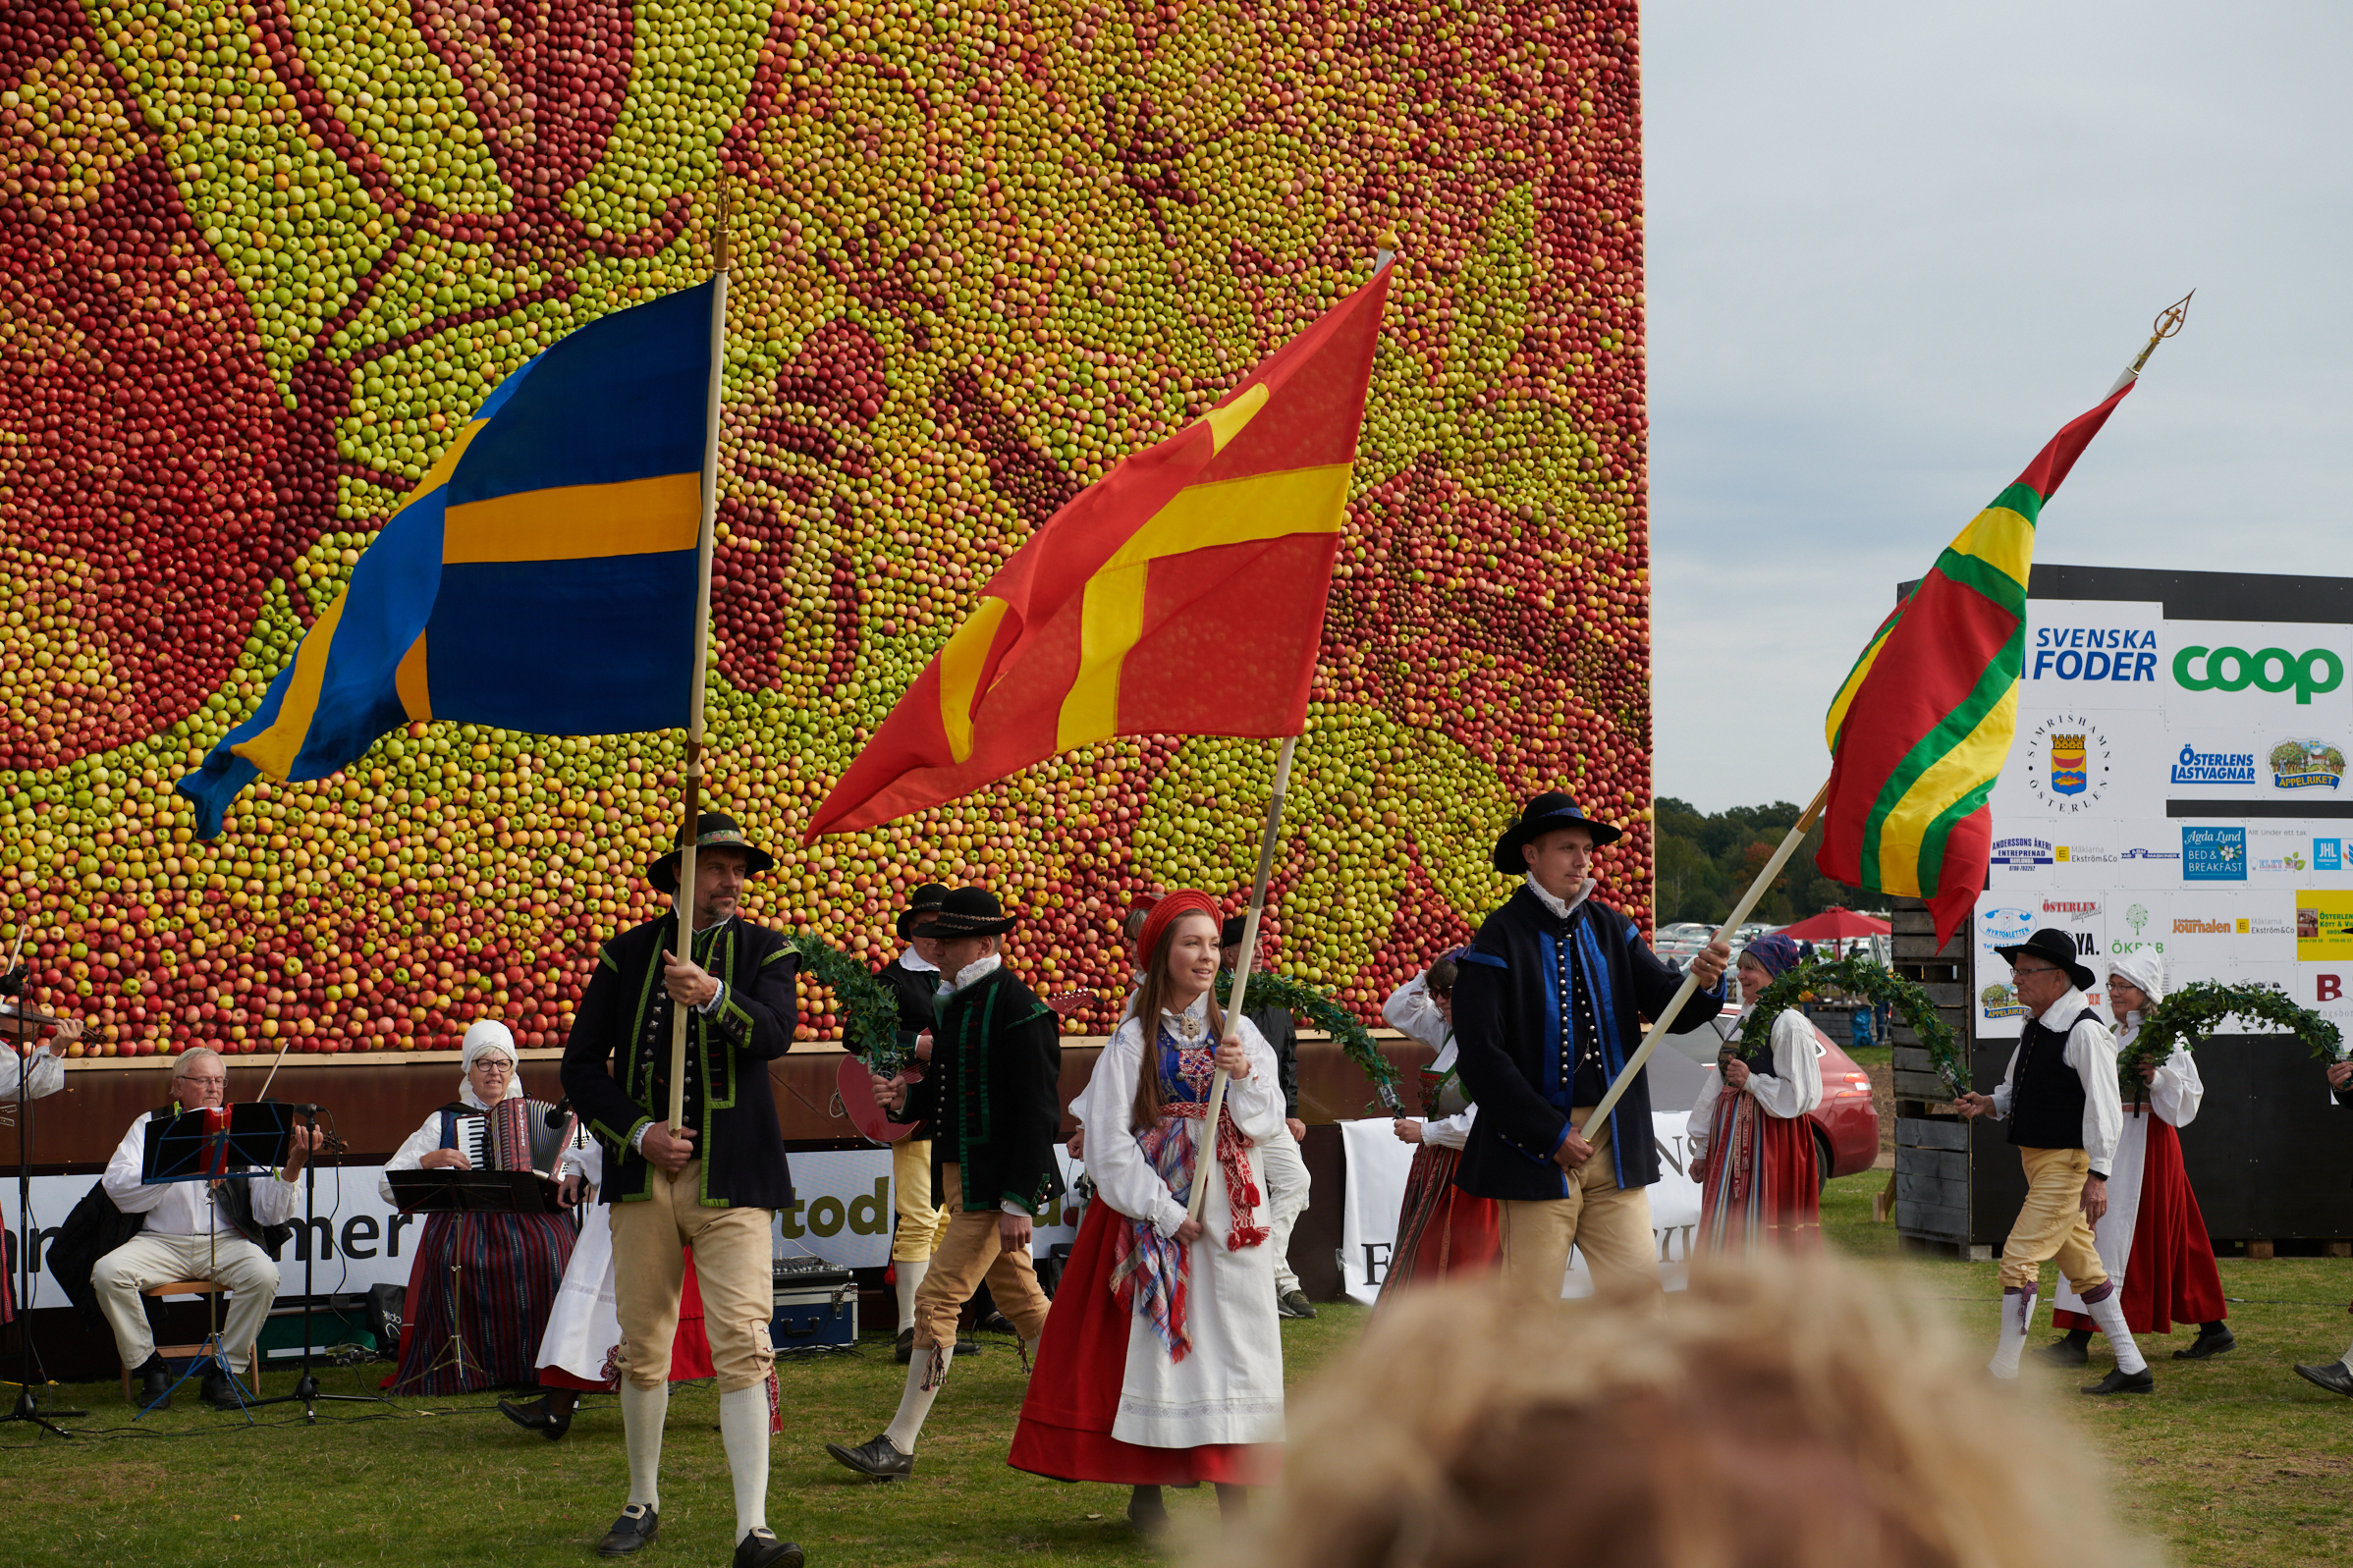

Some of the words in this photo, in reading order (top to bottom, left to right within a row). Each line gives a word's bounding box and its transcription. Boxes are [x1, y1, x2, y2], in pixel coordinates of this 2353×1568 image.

[2036, 627, 2157, 649] SVENSKA
[2033, 649, 2158, 681] FODER
[2172, 645, 2344, 705] coop
[2027, 714, 2111, 759] SIMRISHAMN
[2179, 743, 2254, 767] ÖSTERLENS
[2170, 764, 2256, 784] LASTVAGNAR
[2278, 775, 2334, 787] ÄPPELRIKET
[2029, 780, 2108, 813] ÖSTERLEN
[1992, 838, 2032, 851] ANDERSSONS
[2033, 837, 2052, 851] ÅKERI
[2184, 830, 2214, 845] Agda
[2216, 830, 2242, 844] Lund
[2188, 849, 2208, 860] BED
[2209, 849, 2217, 860] &
[2319, 842, 2337, 858] JHL
[2188, 862, 2243, 872] BREAKFAST
[2043, 898, 2097, 913] ÖSTERLEN
[2172, 918, 2231, 934] Journalen
